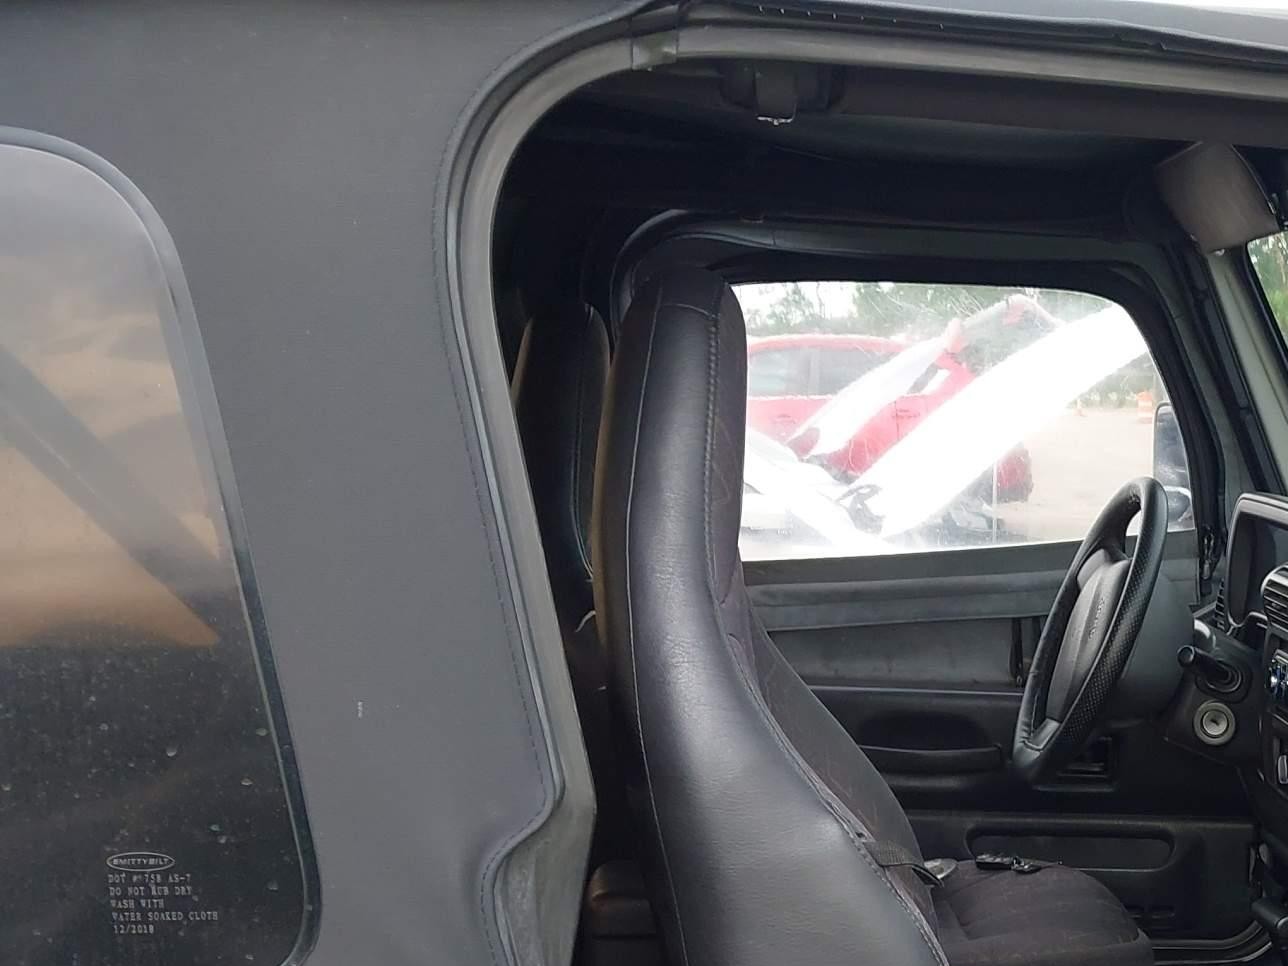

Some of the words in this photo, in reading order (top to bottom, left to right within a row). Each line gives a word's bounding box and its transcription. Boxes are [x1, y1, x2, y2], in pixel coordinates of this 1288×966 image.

[108, 873, 126, 883] DOT
[109, 886, 122, 896] DO
[127, 886, 145, 896] NOT
[151, 886, 169, 896] RUB
[174, 886, 192, 896] DRY
[110, 899, 135, 909] WASH
[140, 899, 165, 909] WITH
[111, 911, 142, 921] WATER
[148, 911, 184, 921] SOAKED
[188, 911, 218, 921] CLOTH
